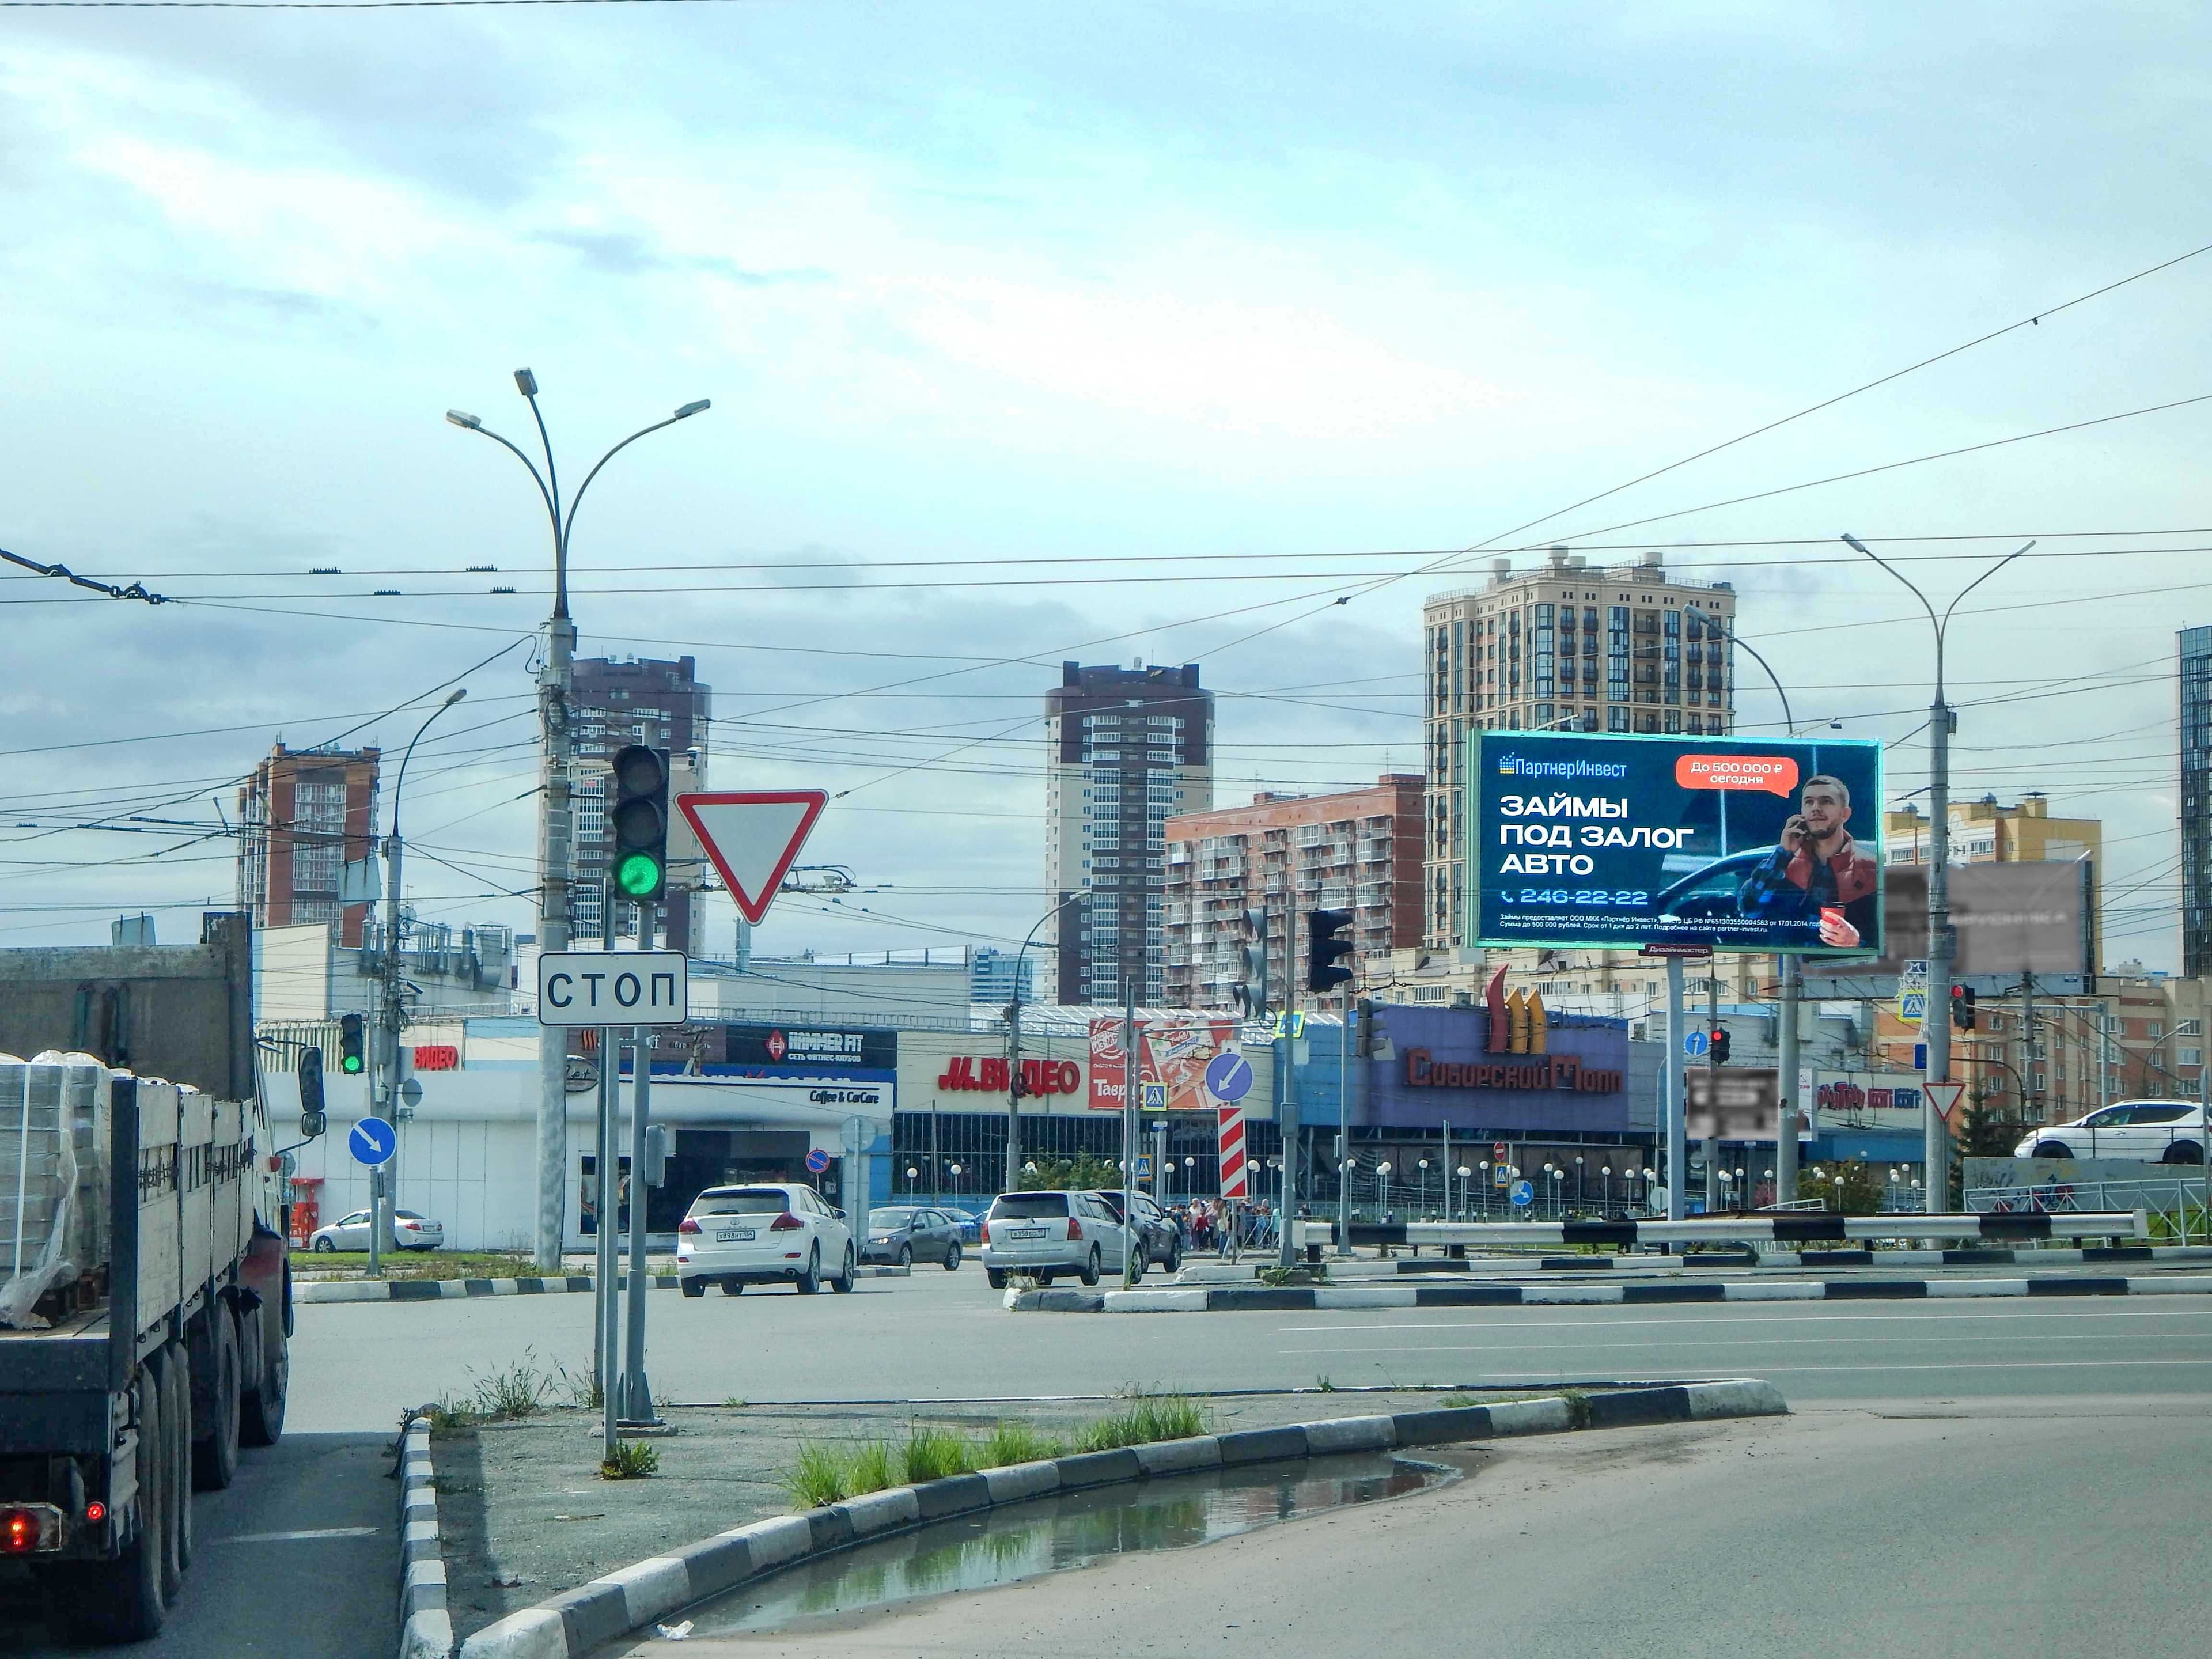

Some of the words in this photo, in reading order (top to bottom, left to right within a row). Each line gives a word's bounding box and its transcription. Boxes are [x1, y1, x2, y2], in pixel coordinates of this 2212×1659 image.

[1515, 758, 1627, 779] ПартнерИнвест
[1691, 762, 1710, 773] До
[1713, 763, 1740, 772] 500
[1742, 763, 1771, 773] 000
[1710, 775, 1763, 785] сегодня
[1500, 791, 1628, 819] ЗАЙМЫ
[1500, 824, 1572, 848] ПОД
[1580, 826, 1694, 849] ЗАЛОГ
[1499, 853, 1594, 875] АВТО
[1520, 889, 1648, 905] 246-22-22
[548, 972, 675, 1007] СТОП
[788, 1032, 843, 1051] HAMMER
[844, 1034, 863, 1052] FIT
[1407, 1048, 1548, 1089] Сибирский
[1549, 1055, 1623, 1092] Молл
[810, 1090, 837, 1104] Coffee
[838, 1091, 844, 1103] &
[847, 1092, 879, 1104] CarCare
